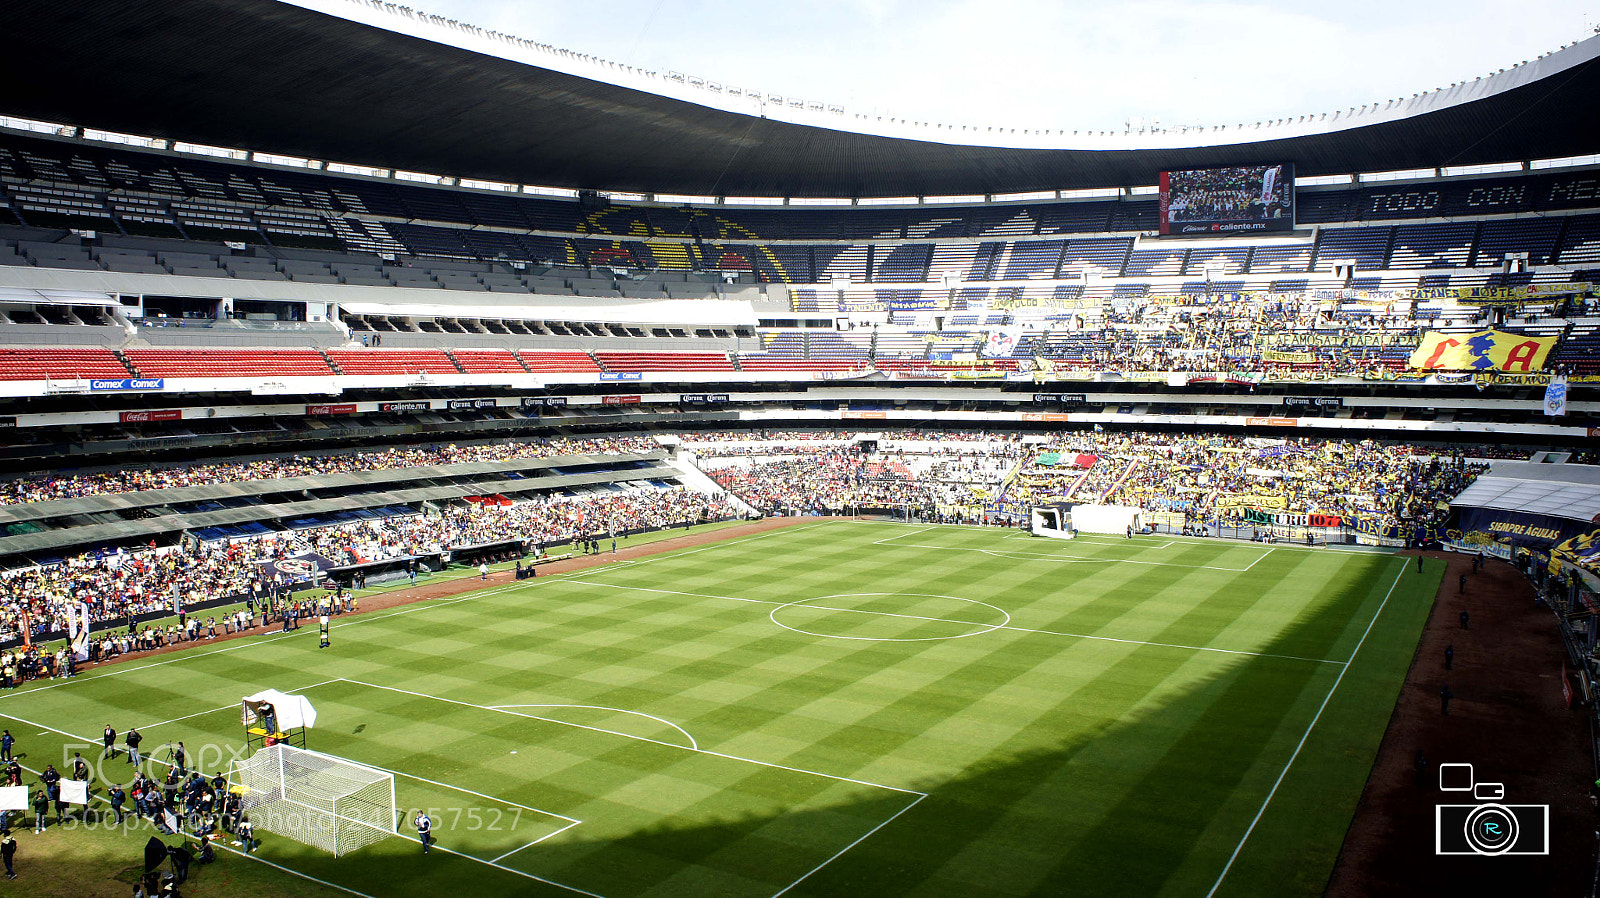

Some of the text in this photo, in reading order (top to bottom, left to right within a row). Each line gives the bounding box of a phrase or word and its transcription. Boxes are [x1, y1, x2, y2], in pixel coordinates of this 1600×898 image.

[1371, 180, 1600, 211] TODO CON ME
[1220, 223, 1266, 231] caliente.mx
[1502, 340, 1541, 371] A
[93, 378, 162, 389] Comex Comex
[390, 402, 427, 411] caliente.mx
[1488, 521, 1561, 540] SIEMPRE ÁGUILAS
